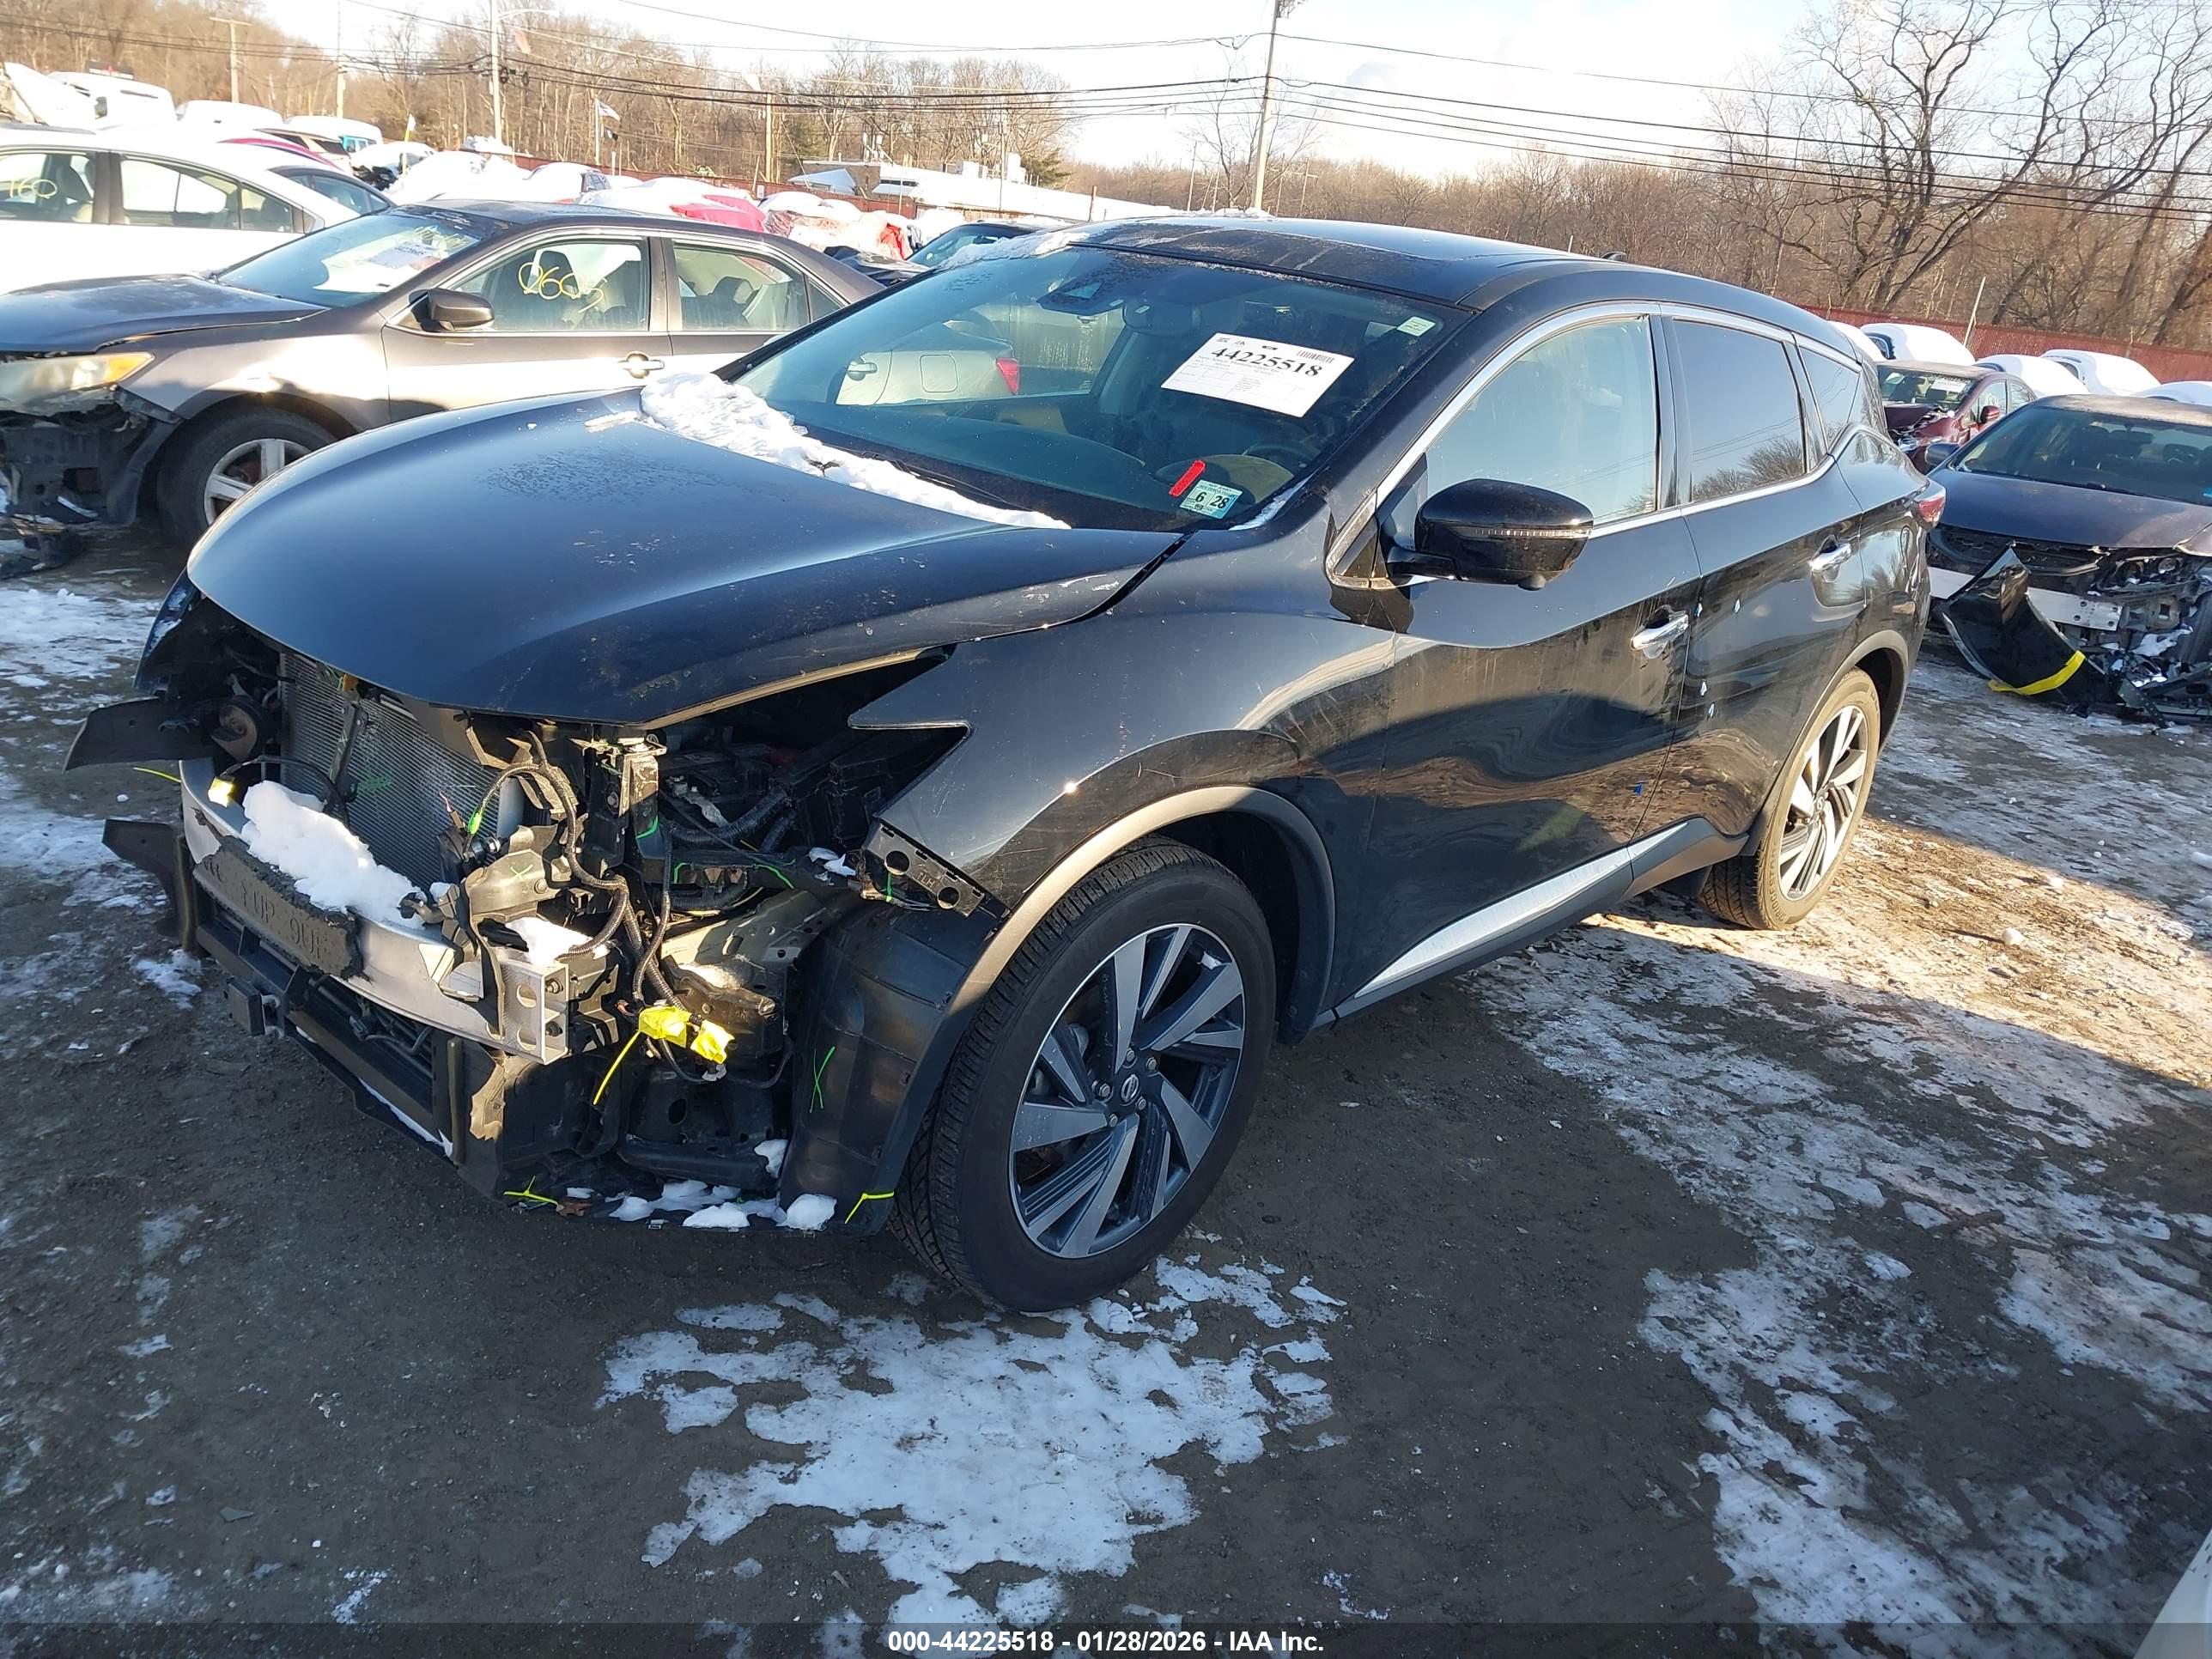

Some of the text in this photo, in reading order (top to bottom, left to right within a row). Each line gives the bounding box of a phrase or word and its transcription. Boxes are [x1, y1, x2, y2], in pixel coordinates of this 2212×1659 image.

[1210, 347, 1323, 378] 44225518
[1194, 491, 1207, 503] 6
[1209, 495, 1231, 509] 28
